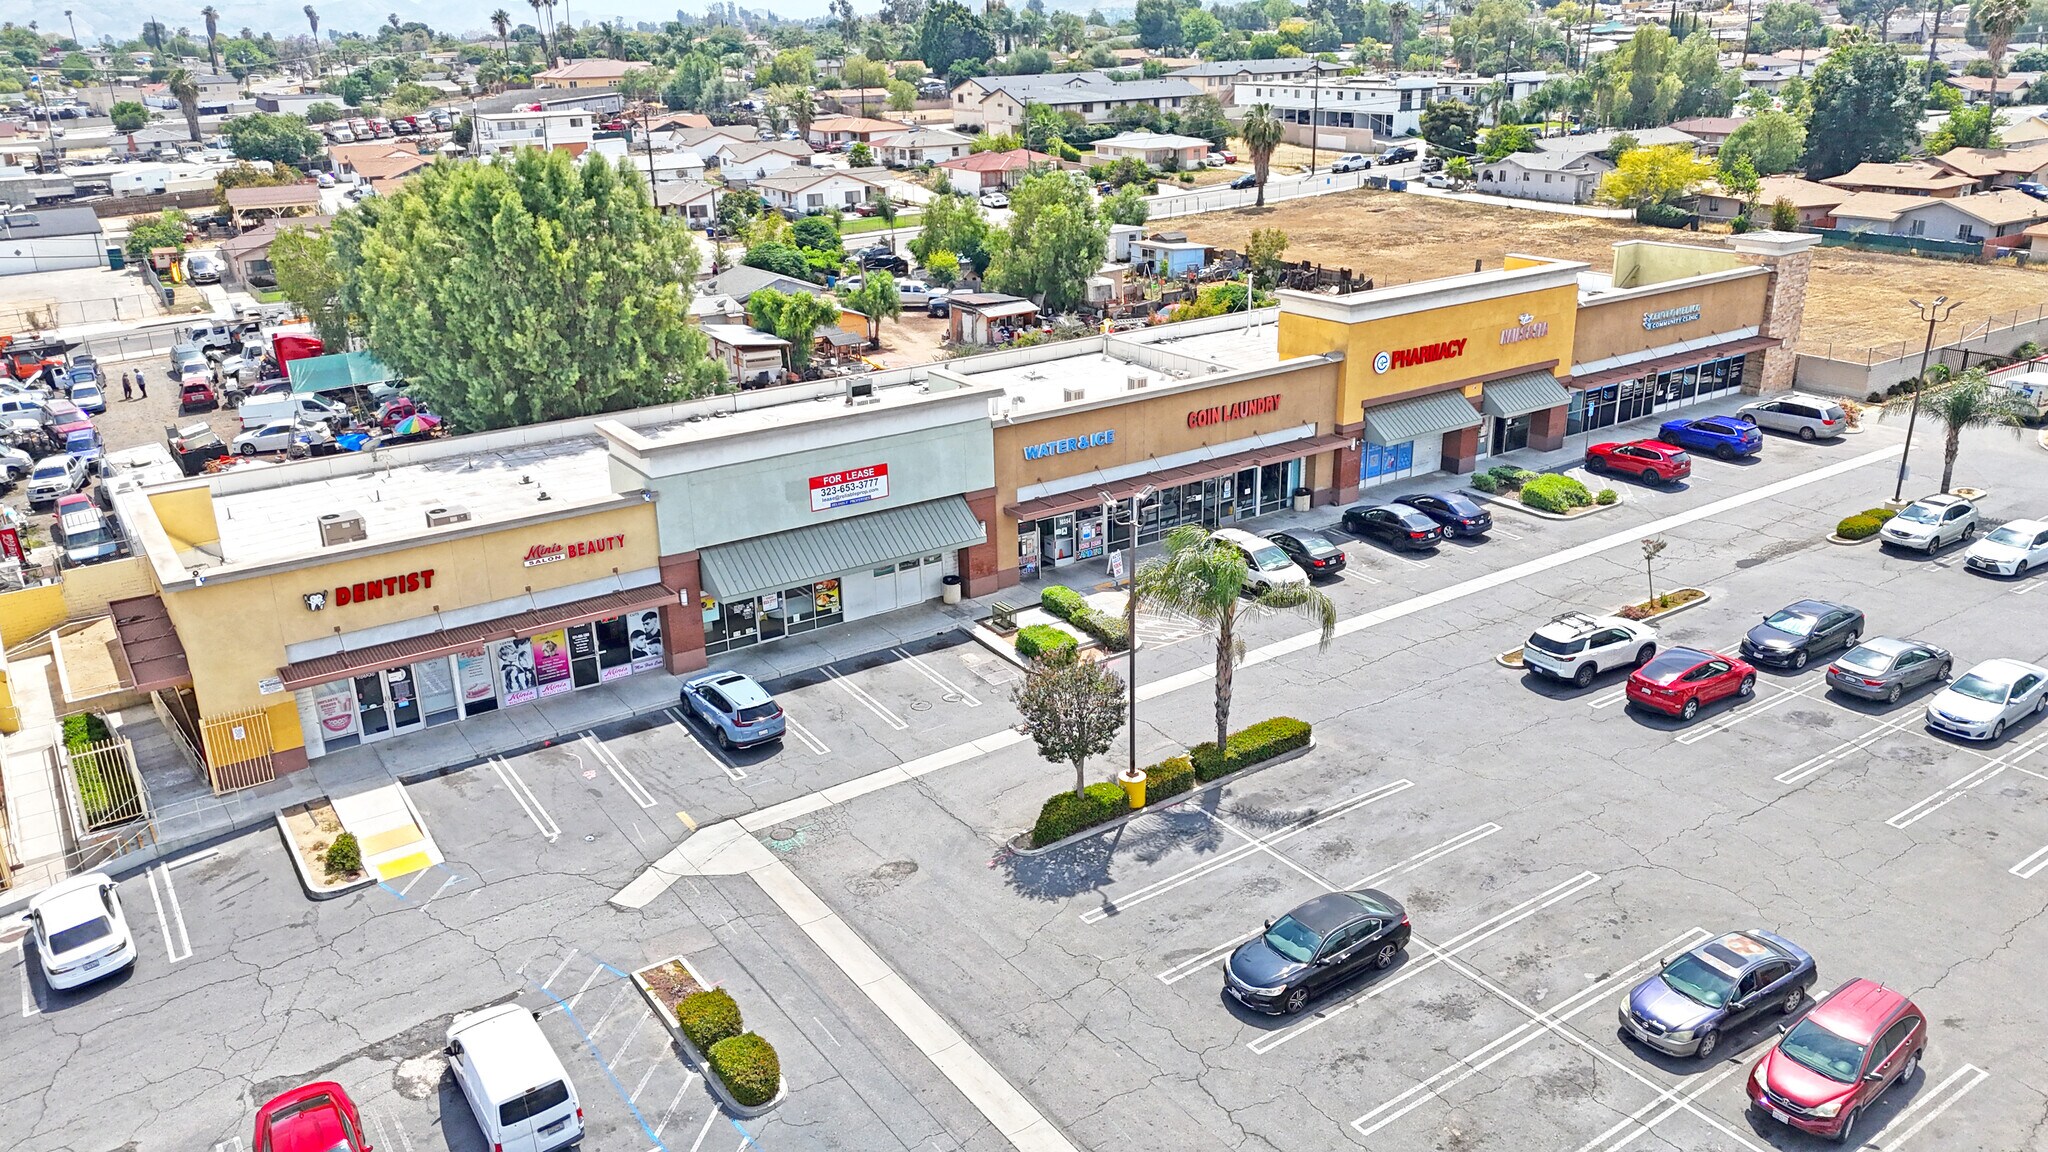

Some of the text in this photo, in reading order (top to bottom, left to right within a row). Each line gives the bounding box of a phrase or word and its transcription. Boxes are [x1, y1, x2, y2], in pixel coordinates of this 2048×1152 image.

[1652, 314, 1699, 329] COMMUNITY CLINIC
[1391, 338, 1467, 370] PHARMACY
[1187, 394, 1281, 429] COIN LAUNDRY
[1023, 429, 1116, 460] WATER & ICE
[820, 477, 879, 497] 323-653-3777
[823, 467, 875, 485] FOR LEASE
[1, 534, 20, 559] oca-Cola
[523, 534, 625, 560] Minis BEAUTY
[528, 555, 562, 566] SALON
[335, 569, 435, 607] DENTIST
[508, 691, 533, 702] Minis
[542, 681, 567, 693] Minis
